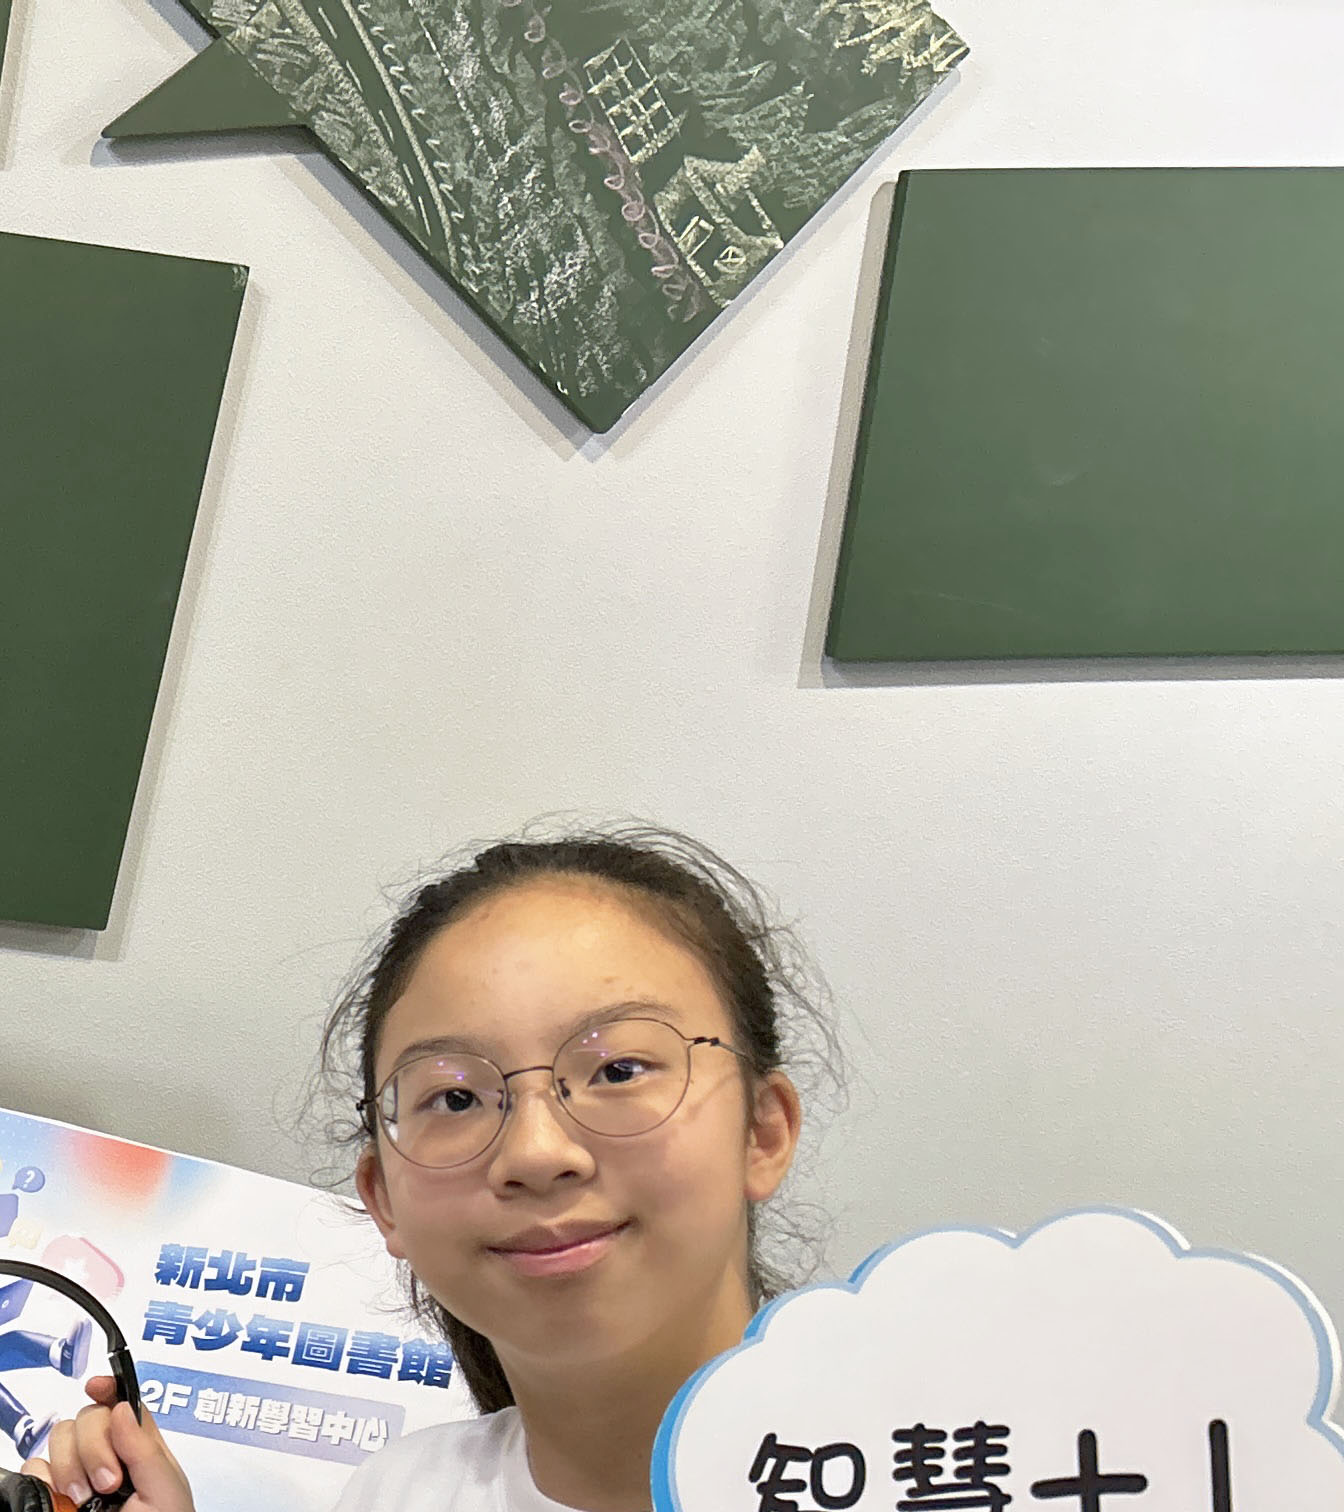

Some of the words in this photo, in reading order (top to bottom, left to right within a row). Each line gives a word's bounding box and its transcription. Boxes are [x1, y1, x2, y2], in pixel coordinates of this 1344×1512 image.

[154, 1242, 311, 1304] 新北市
[140, 1299, 456, 1390] 青少年圖書館
[139, 1375, 194, 1416] 2F
[194, 1385, 391, 1454] 創新學習中心
